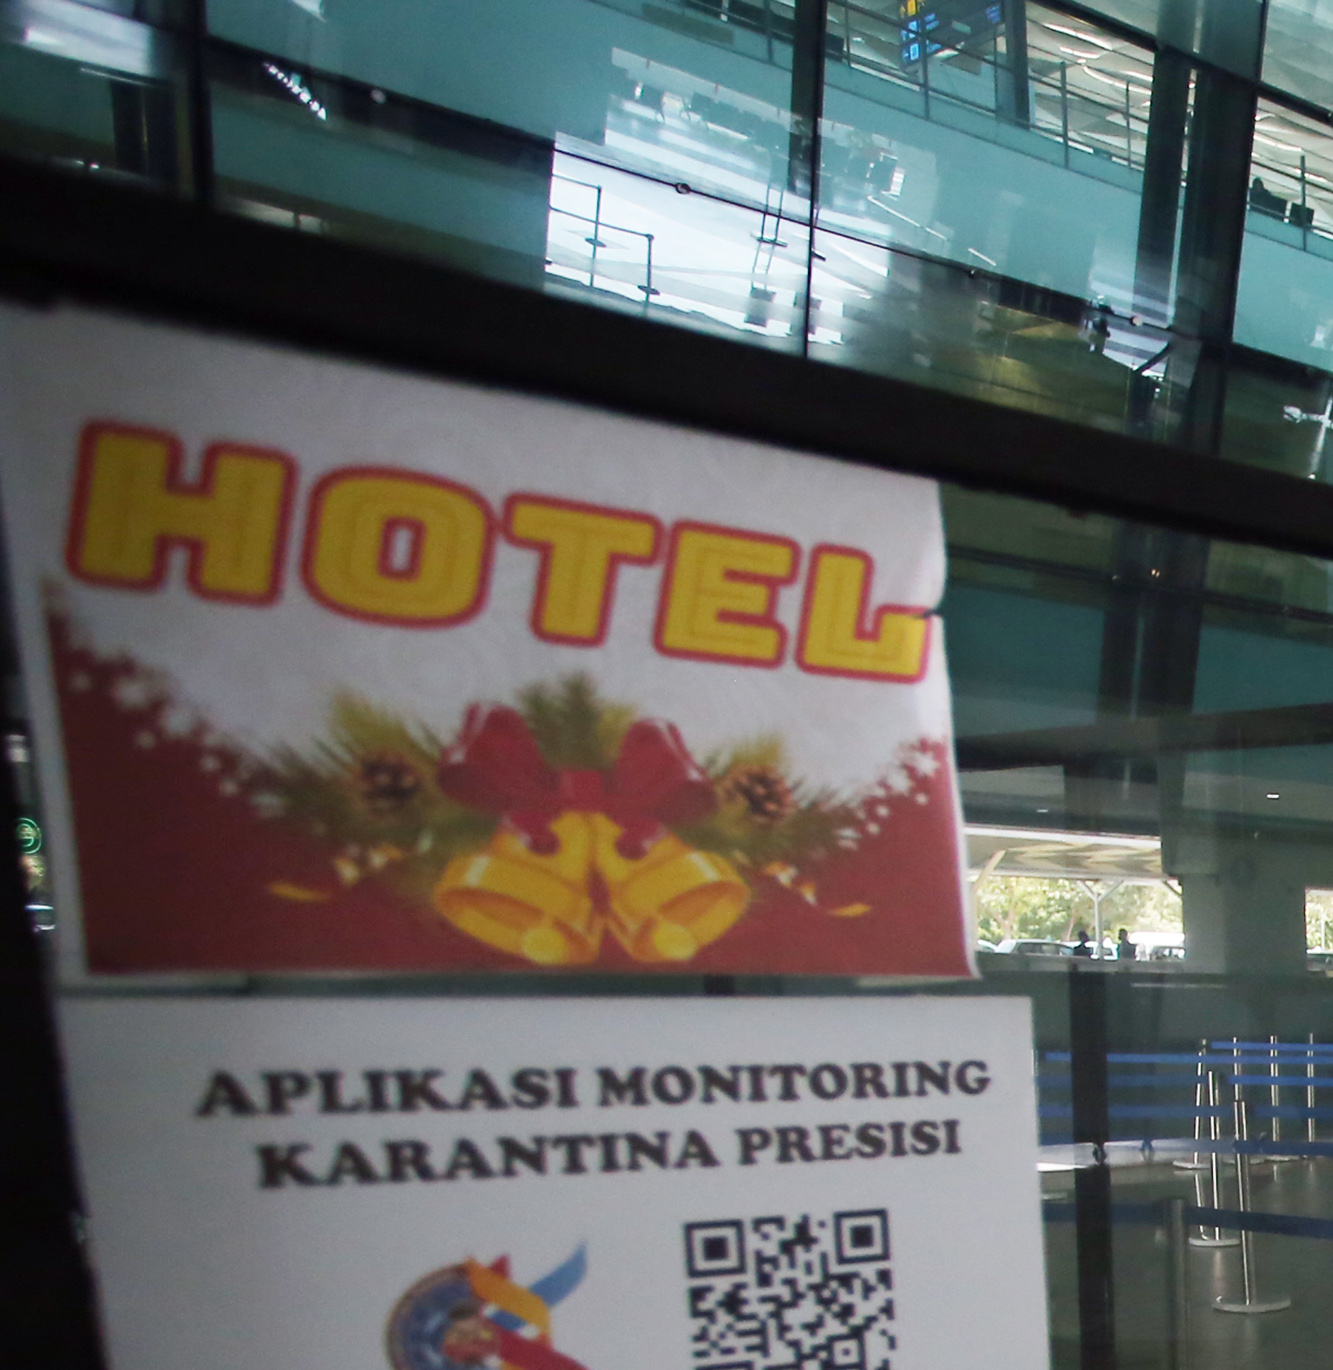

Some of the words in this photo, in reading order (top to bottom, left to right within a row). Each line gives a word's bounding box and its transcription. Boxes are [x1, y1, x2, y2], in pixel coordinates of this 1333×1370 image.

[64, 418, 933, 685] HOTEL
[196, 1064, 578, 1120] APLIKASI
[595, 1059, 993, 1110] MONITORING
[255, 1126, 720, 1190] KARANTINA
[735, 1117, 962, 1167] PRESISI
